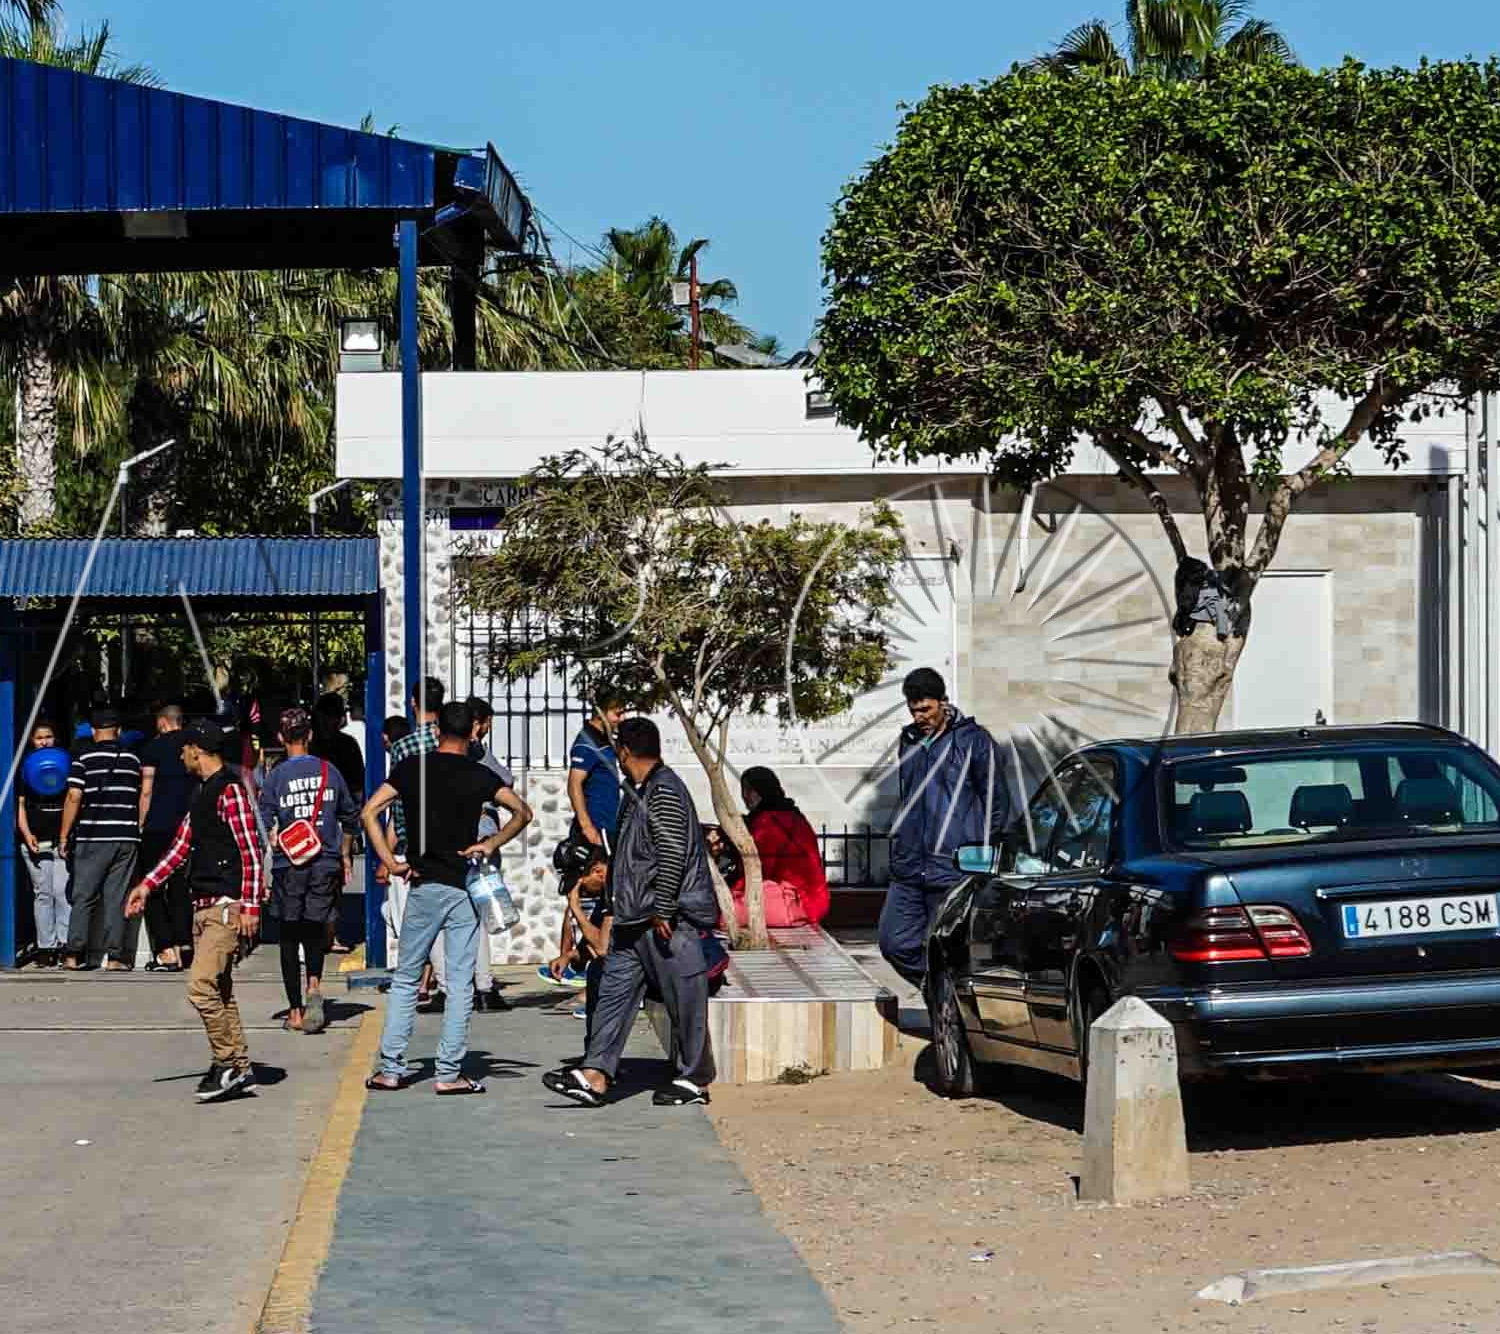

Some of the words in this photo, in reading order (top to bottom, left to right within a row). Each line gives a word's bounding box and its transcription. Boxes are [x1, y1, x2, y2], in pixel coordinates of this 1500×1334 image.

[279, 792, 308, 808] LOSE
[1364, 904, 1432, 932] 4188
[1440, 898, 1492, 926] CSM
